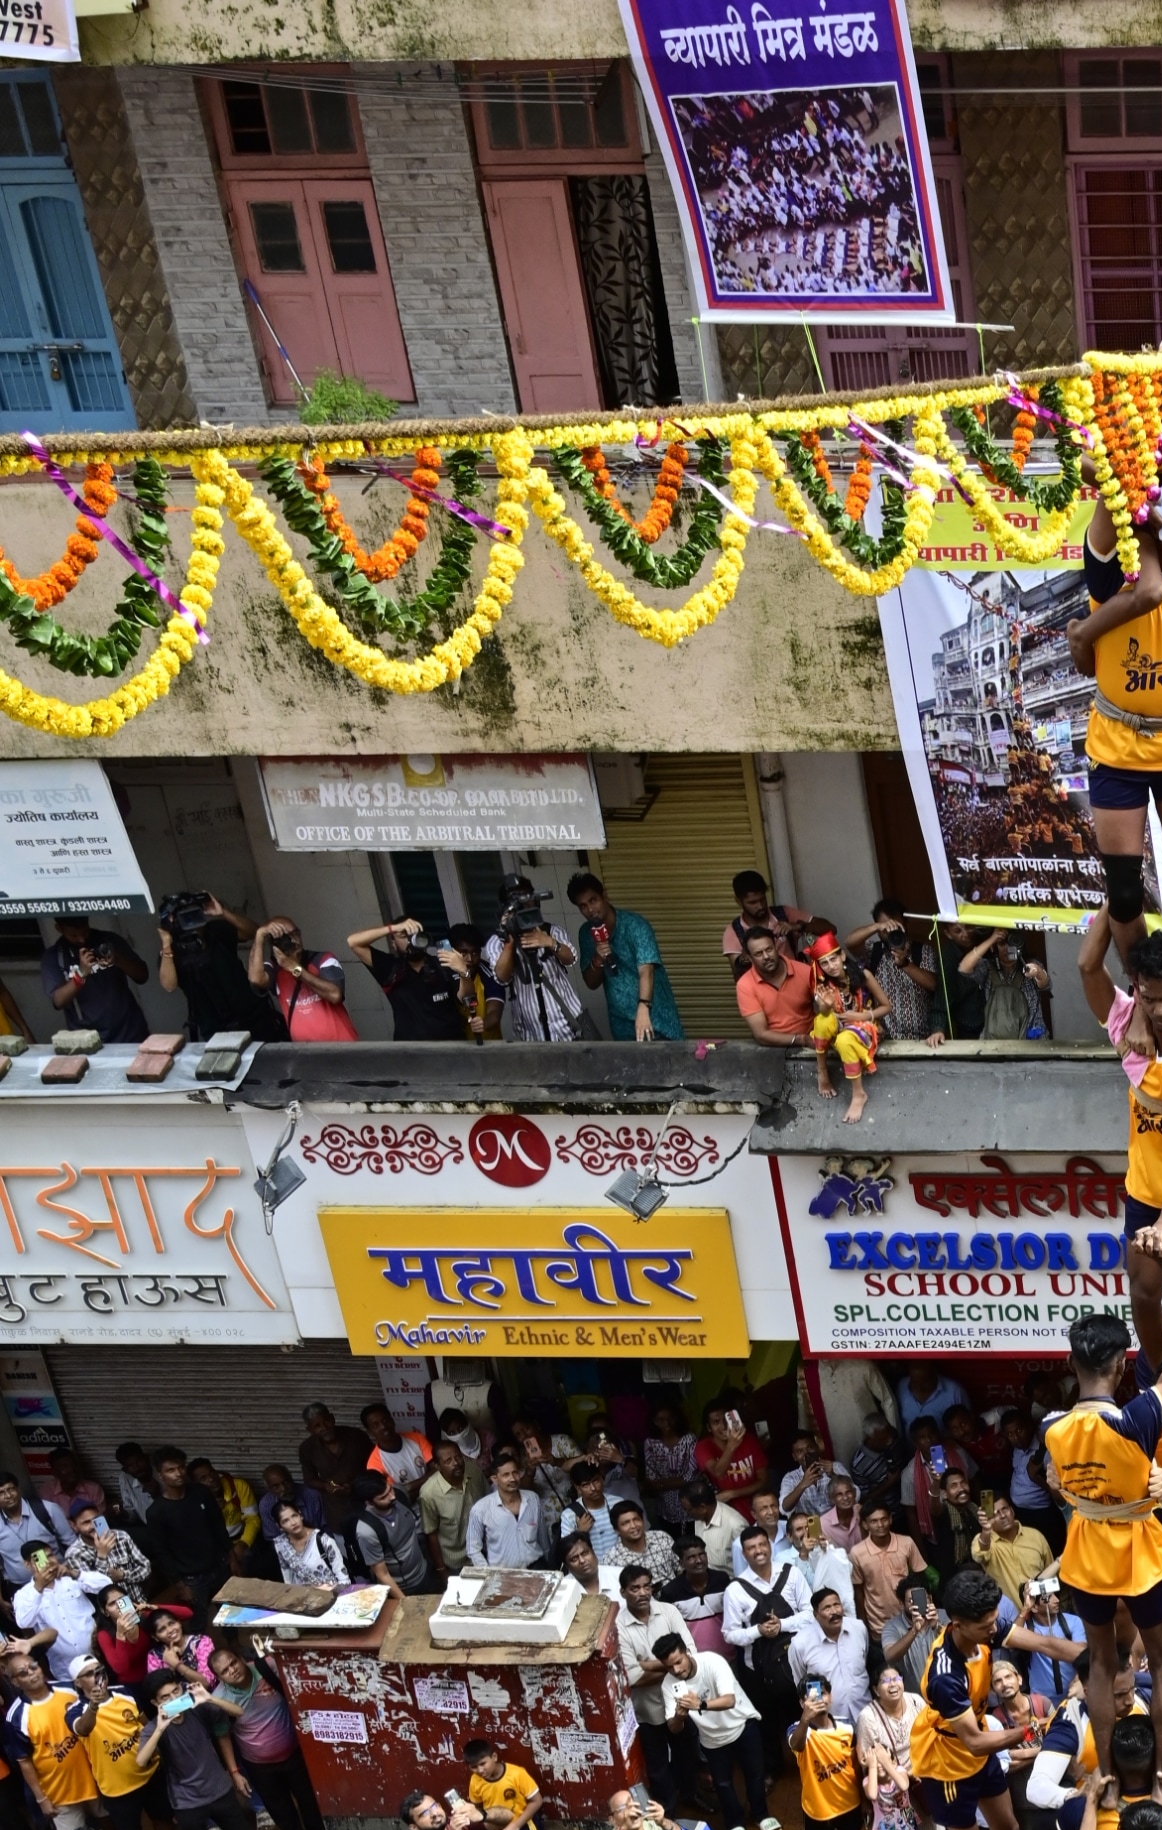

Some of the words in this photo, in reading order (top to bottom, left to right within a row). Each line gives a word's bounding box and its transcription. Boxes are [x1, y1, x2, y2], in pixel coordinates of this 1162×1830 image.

[660, 3, 751, 69] व्यापारी
[752, 9, 806, 64] मित्र
[810, 0, 879, 59] मंडळ
[319, 783, 400, 808] NKGSB
[4, 811, 47, 823] ज्योतिष
[49, 810, 99, 821] कार्यालय
[357, 807, 415, 818] Multi-State
[419, 808, 476, 818] Scheduled
[480, 807, 506, 817] Bank
[296, 826, 350, 841] OFFICE
[354, 826, 375, 840] OF
[379, 826, 412, 841] THE
[416, 826, 496, 841] ARBITRAL
[499, 824, 581, 841] TRIBUNAL
[27, 902, 60, 913] 55628
[68, 899, 131, 911] 9321054480
[825, 1232, 1079, 1270] EXCELSIOR
[366, 1223, 697, 1309] महावीर
[864, 1273, 1036, 1296] SCHOOL
[75, 1274, 228, 1314] हाऊस
[834, 1304, 1039, 1322] SPL.COLLECTION
[374, 1320, 487, 1349] Mahavir
[504, 1326, 570, 1346] Ethnic
[575, 1326, 593, 1346] &
[832, 1328, 916, 1337] COMPOSITION
[920, 1328, 974, 1337] TAXABLE
[978, 1328, 1029, 1337] PERSON
[1032, 1328, 1056, 1337] NOT
[831, 1340, 871, 1349] GSTIN:
[874, 1340, 991, 1349] 27AAAFE2494E1ZM
[20, 1433, 66, 1443] adidas
[315, 1731, 363, 1741] 8983182915
